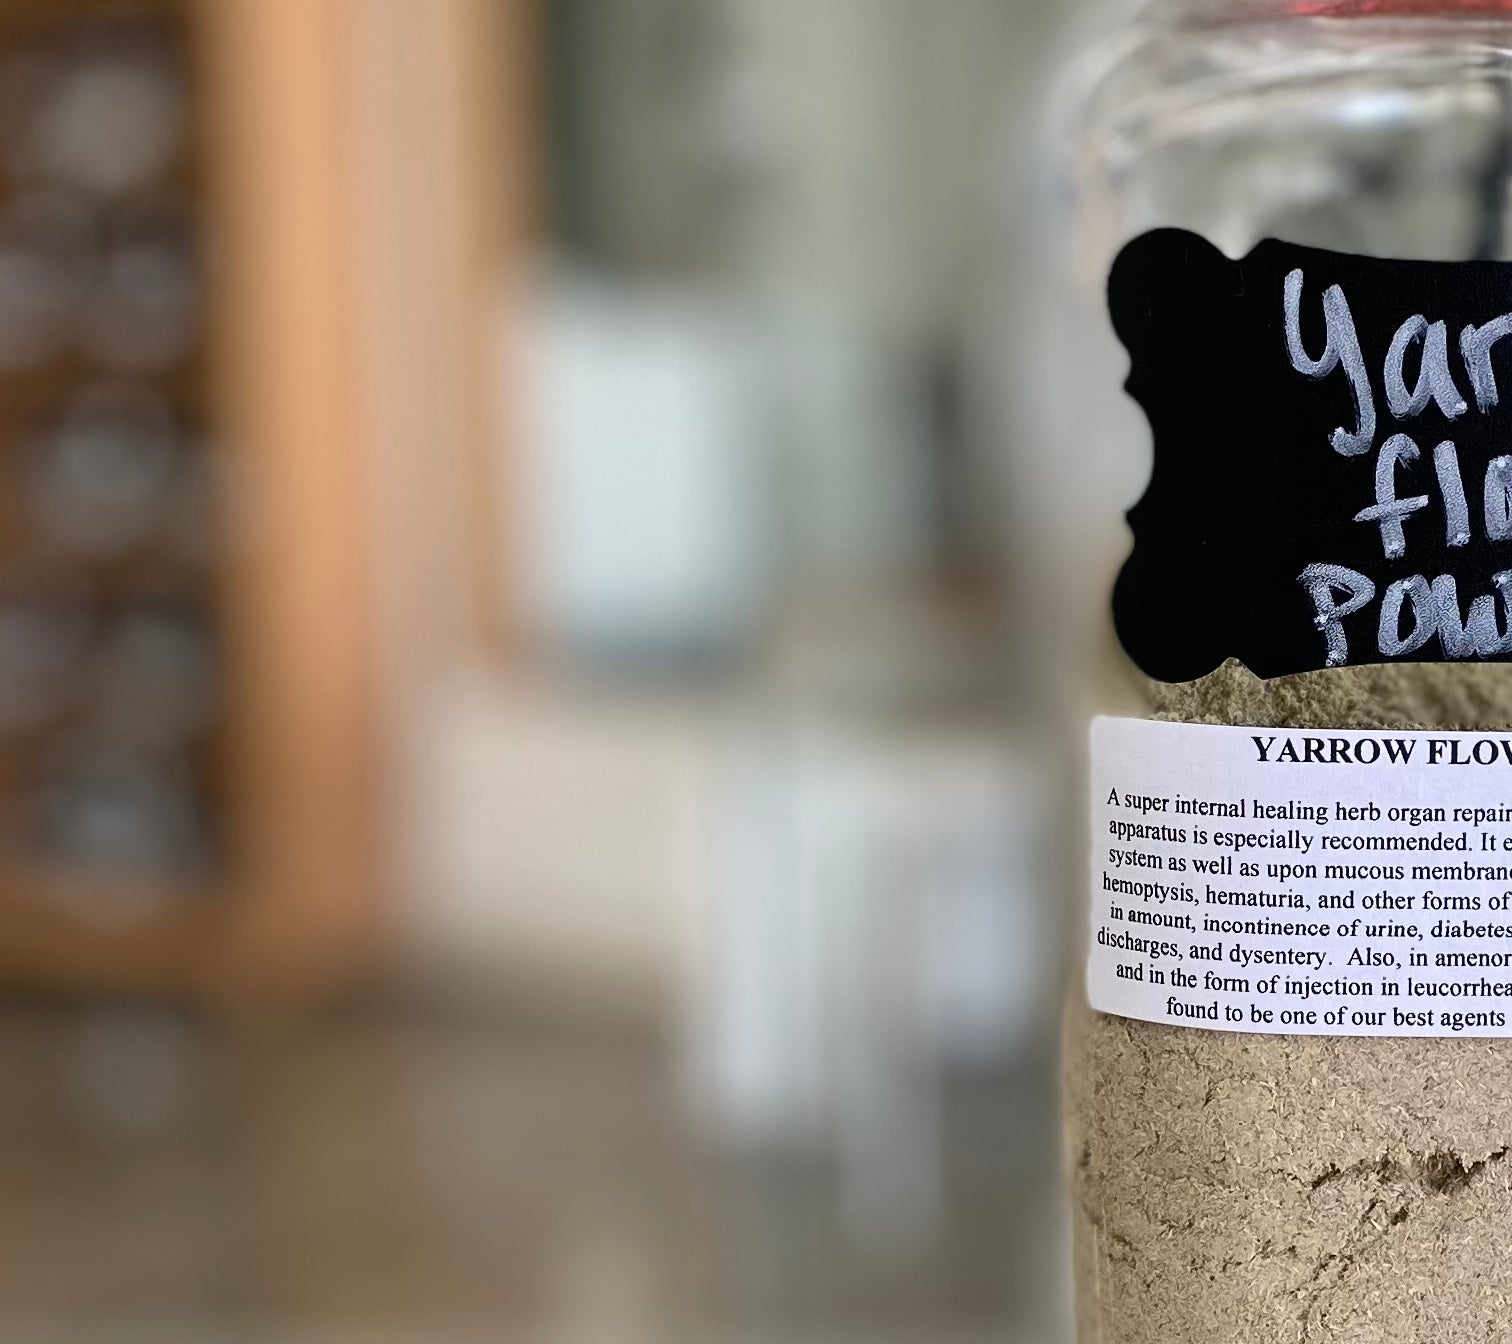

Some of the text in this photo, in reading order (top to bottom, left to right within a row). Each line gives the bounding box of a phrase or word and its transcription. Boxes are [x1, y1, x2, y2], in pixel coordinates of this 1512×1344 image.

[1250, 735, 1418, 765] YARROW
[1106, 786, 1121, 807] A
[1121, 793, 1170, 818] super
[1174, 793, 1246, 819] internal
[1252, 799, 1329, 826] healing
[1334, 801, 1382, 822] herb
[1387, 807, 1447, 827] organ
[1109, 817, 1187, 847] apparatus
[1192, 824, 1208, 845] is
[1213, 828, 1315, 855] especially
[1320, 831, 1473, 852] recommended.
[1480, 831, 1498, 852] It
[1108, 844, 1164, 873] system
[1167, 856, 1189, 873] as
[1191, 855, 1233, 876] well
[1239, 862, 1260, 878] as
[1266, 863, 1318, 884] upon
[1323, 864, 1405, 881] mucous
[1102, 869, 1200, 909] hemoptysis,
[1204, 883, 1312, 913] hematuria,
[1317, 889, 1356, 910] and
[1361, 889, 1416, 910] other
[1421, 890, 1482, 911] forms
[1110, 900, 1126, 921] in
[1124, 903, 1197, 935] amount,
[1203, 912, 1331, 938] incontinence
[1336, 918, 1363, 938] of
[1364, 918, 1424, 942] urine,
[1097, 925, 1185, 962] discharges,
[1188, 941, 1223, 962] and
[1228, 943, 1333, 971] dysentery.
[1345, 946, 1402, 971] Also,
[1408, 946, 1429, 967] in
[1116, 959, 1144, 982] and
[1147, 962, 1167, 985] in
[1170, 967, 1198, 989] the
[1202, 970, 1251, 993] form
[1256, 974, 1281, 994] of
[1283, 974, 1374, 1001] injection
[1380, 976, 1401, 997] in
[1165, 995, 1220, 1021] found
[1224, 1004, 1244, 1023] to
[1249, 1003, 1274, 1024] be
[1279, 1010, 1318, 1025] one
[1323, 1005, 1349, 1026] of
[1351, 1011, 1387, 1027] our
[1392, 1006, 1435, 1027] best
[1440, 1009, 1506, 1032] agents
